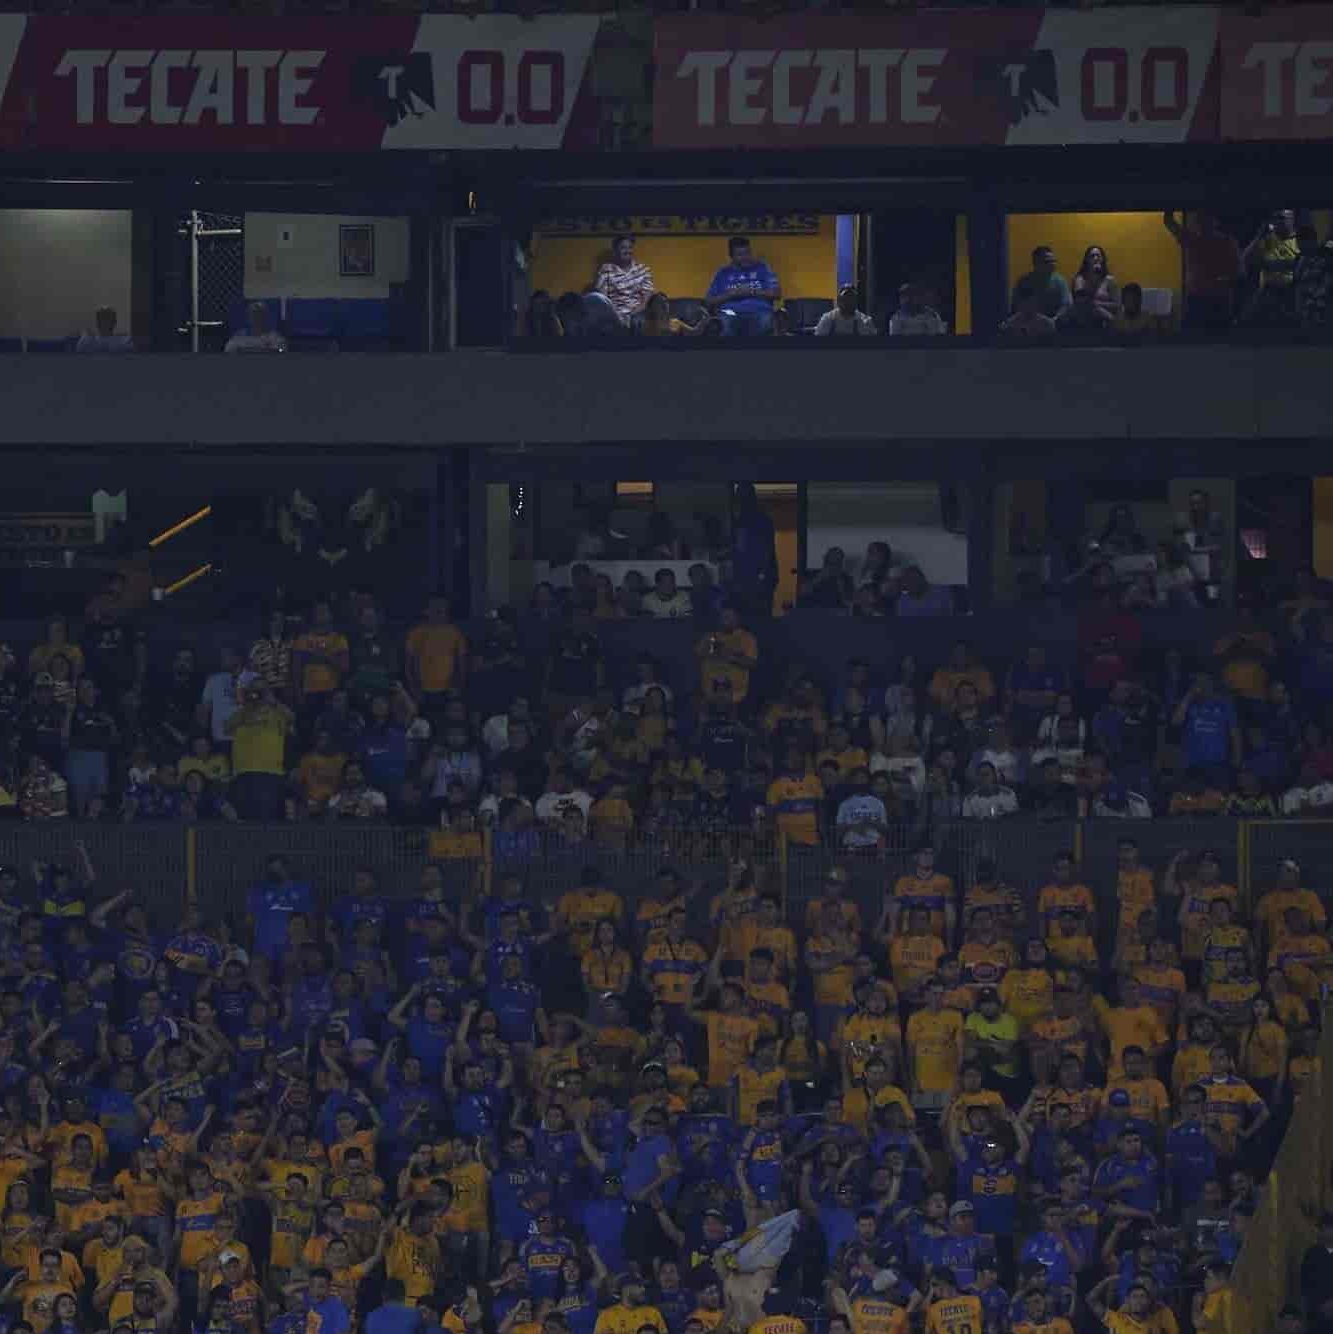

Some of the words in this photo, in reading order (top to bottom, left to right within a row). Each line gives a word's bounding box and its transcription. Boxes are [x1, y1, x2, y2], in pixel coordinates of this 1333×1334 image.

[52, 48, 326, 126] TECATE
[456, 49, 565, 126] 0.0
[674, 48, 949, 126] TECATE
[1080, 46, 1188, 126] 0.0
